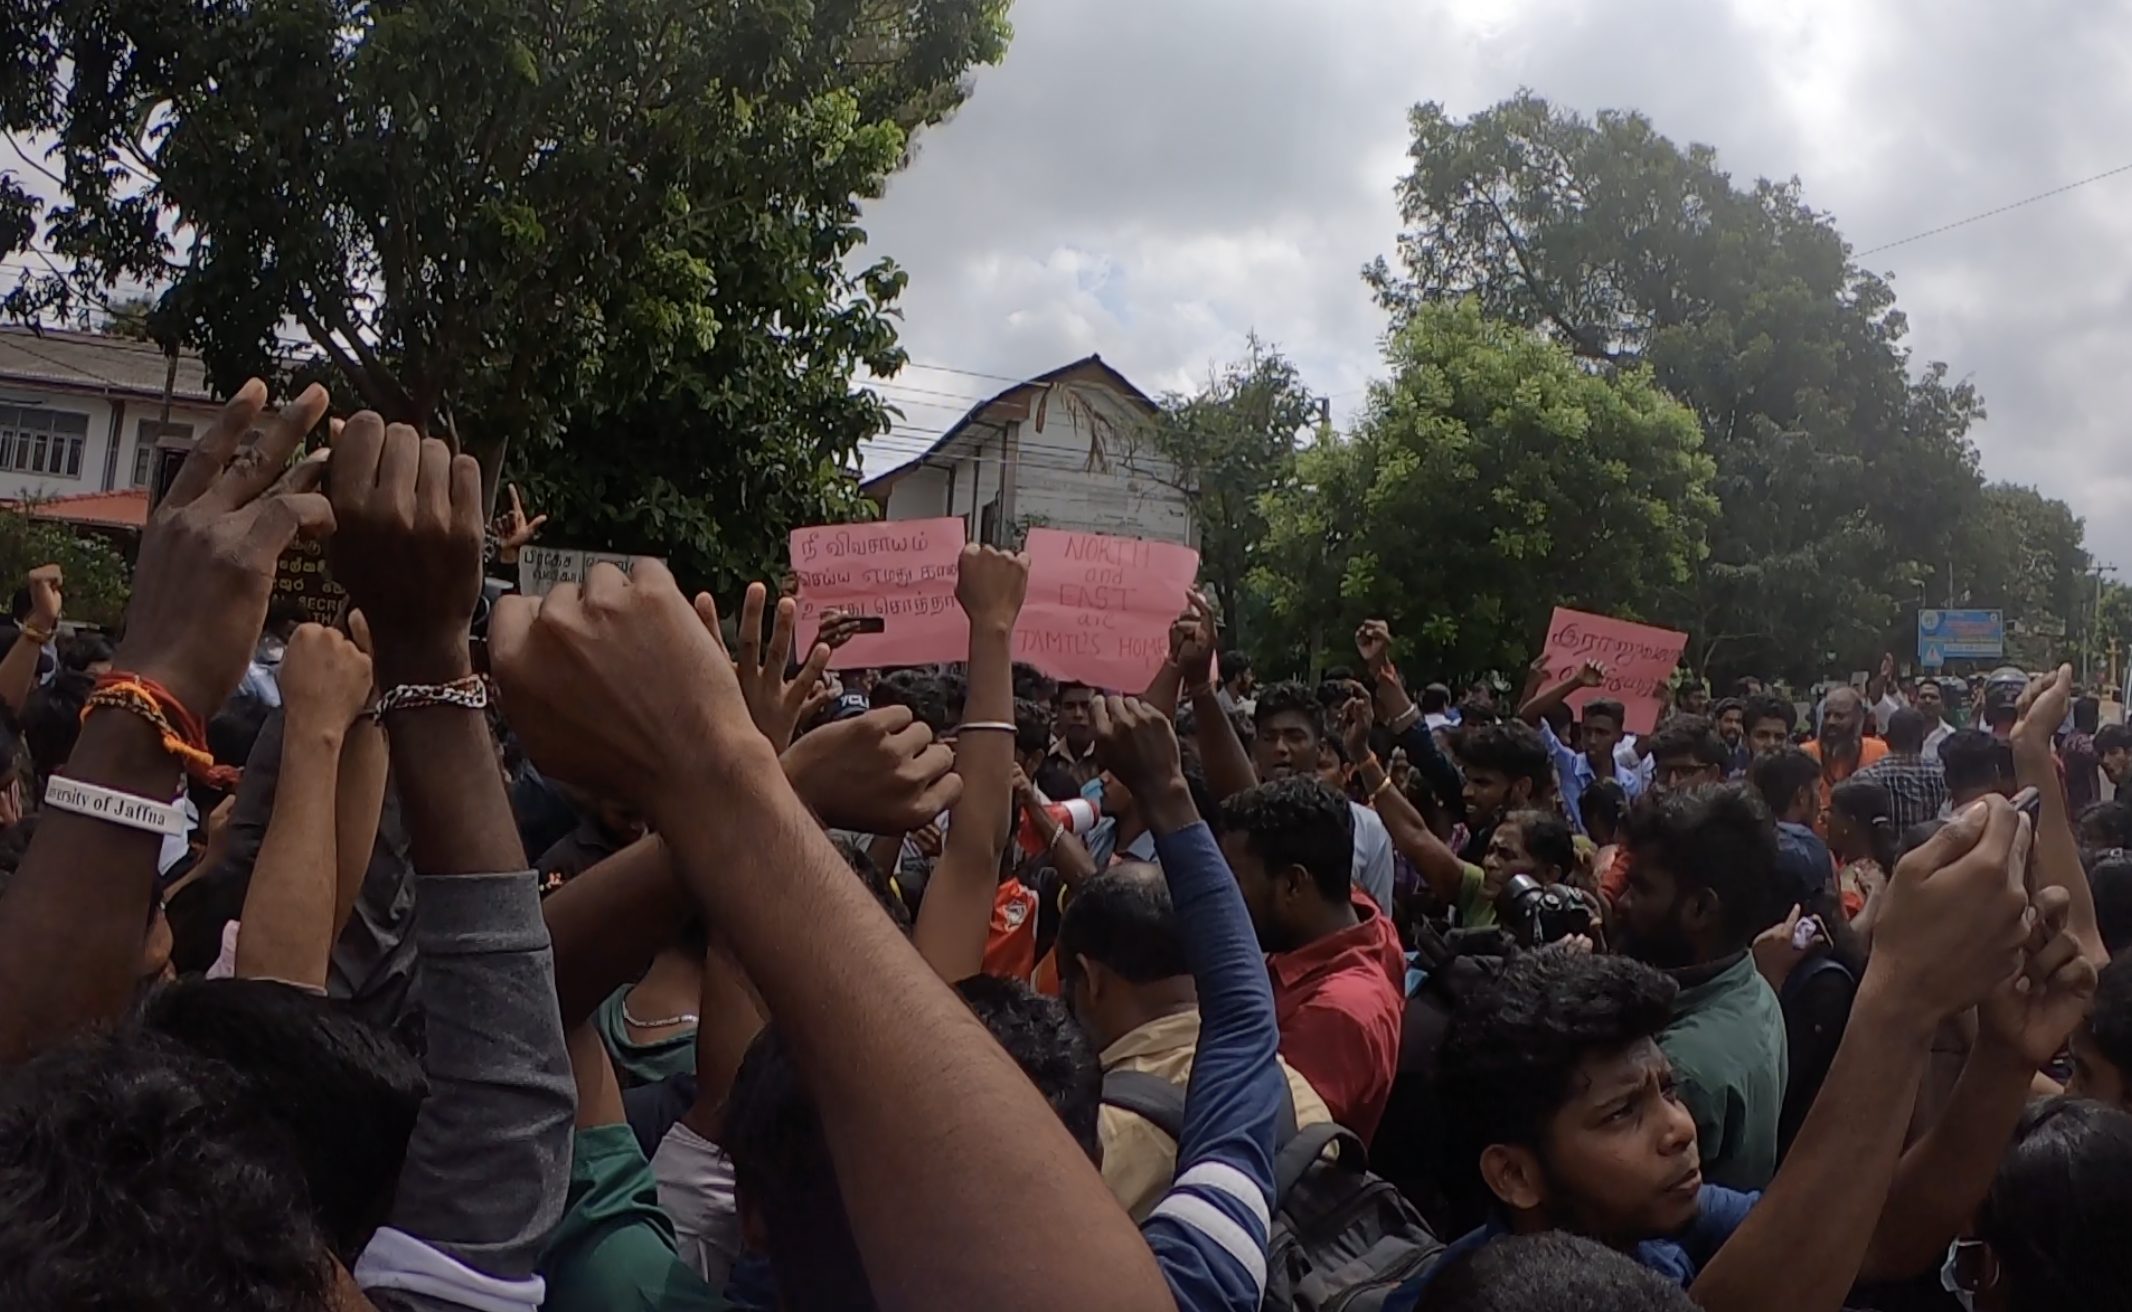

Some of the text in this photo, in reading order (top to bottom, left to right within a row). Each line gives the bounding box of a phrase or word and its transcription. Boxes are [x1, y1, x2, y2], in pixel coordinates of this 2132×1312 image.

[801, 530, 930, 563] நீ விவசாயம்
[1064, 536, 1151, 568] NORTH
[799, 567, 851, 587] செய்ய
[862, 566, 913, 588] எமது
[1085, 567, 1124, 585] and
[1059, 584, 1137, 611] EAST
[1077, 613, 1115, 630] are
[94, 795, 113, 812] of
[114, 799, 166, 827] Jaffna
